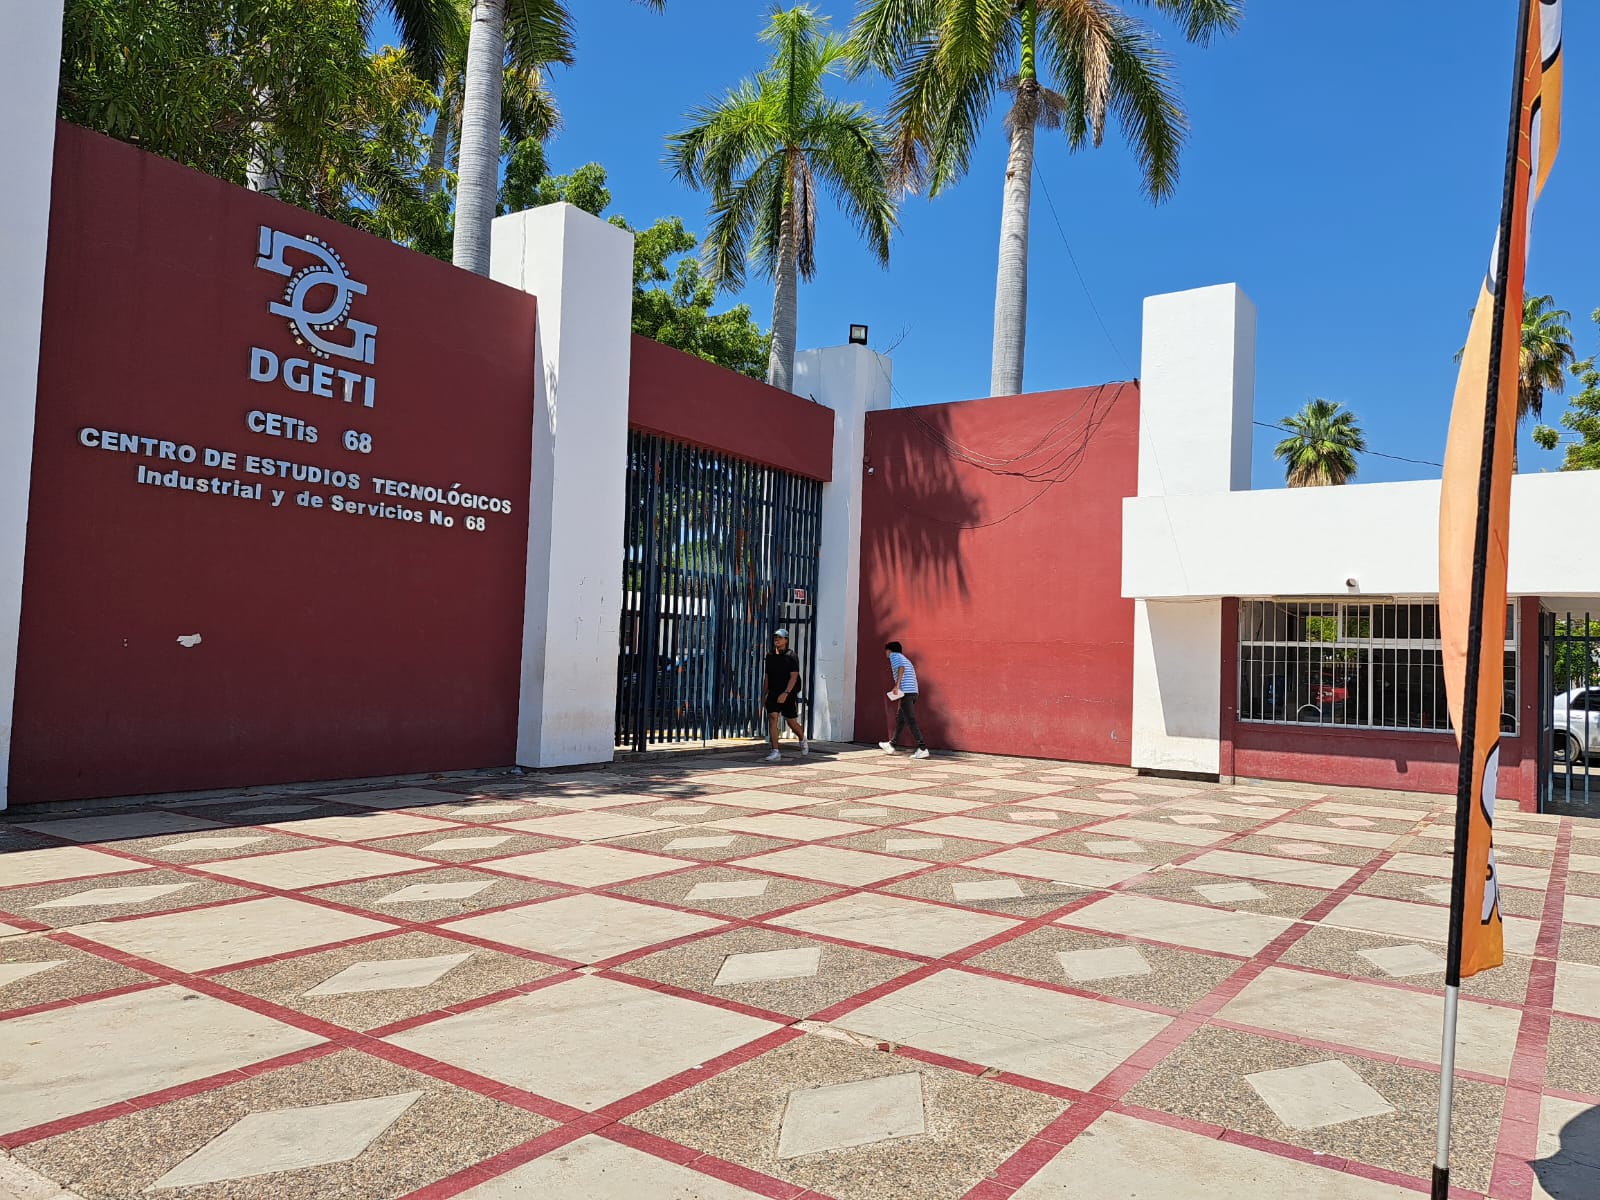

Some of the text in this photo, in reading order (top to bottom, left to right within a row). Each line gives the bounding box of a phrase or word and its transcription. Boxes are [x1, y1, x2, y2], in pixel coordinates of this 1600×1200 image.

[250, 346, 376, 408] DGETI
[247, 410, 372, 454] CETis 68
[80, 427, 512, 514] CENTRO DE ESTUDIOS TECNOLÓGICOS
[137, 466, 486, 532] Industrial y de Servicios No 68
